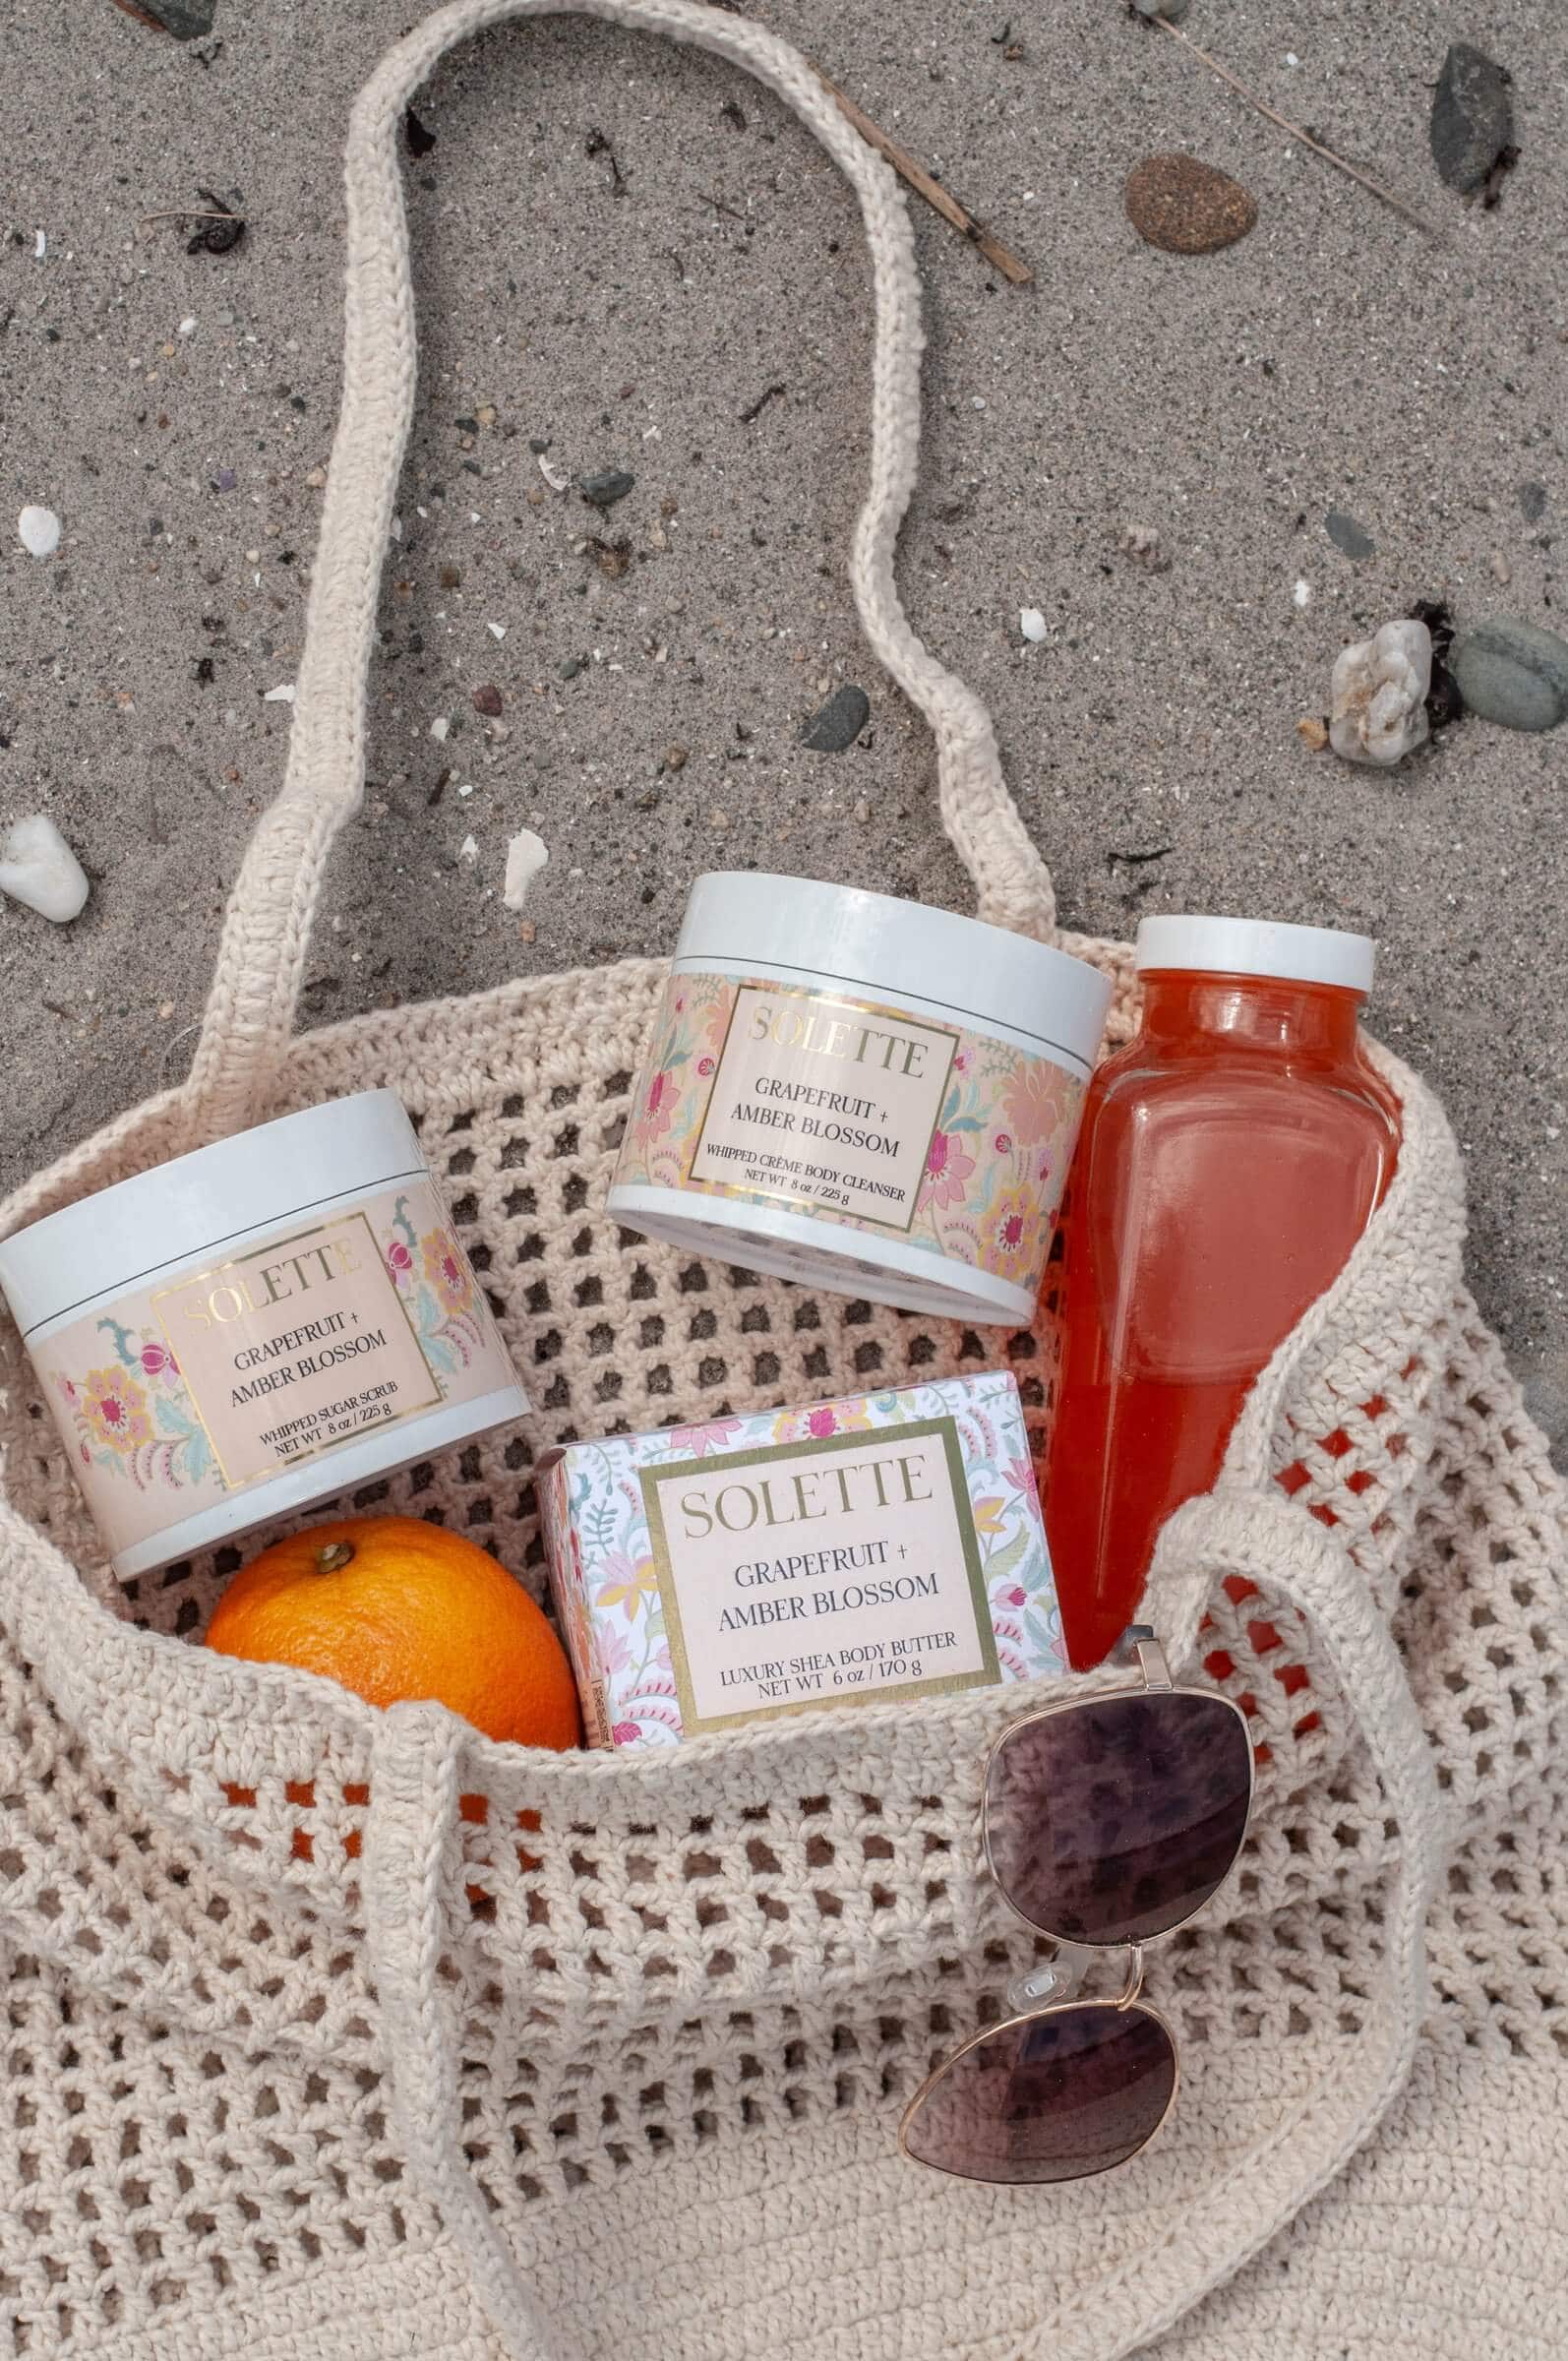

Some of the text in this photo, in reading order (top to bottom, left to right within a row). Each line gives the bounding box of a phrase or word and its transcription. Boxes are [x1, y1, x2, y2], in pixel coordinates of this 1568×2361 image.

[751, 1005, 929, 1079] SOLETTE
[754, 1077, 876, 1120] GRAPEFRUIT
[730, 1103, 900, 1157] AMBER BLOSSOM
[706, 1143, 757, 1164] WHIPPED
[805, 1165, 840, 1183] BODY
[842, 1175, 906, 1202] CLEANSER
[745, 1168, 766, 1183] NET
[768, 1173, 788, 1187] WT
[791, 1180, 798, 1189] 8
[800, 1183, 812, 1193] oz
[820, 1185, 840, 1200] 225
[184, 1238, 362, 1330] SOLETTE
[230, 1329, 387, 1408] AMBER BLOSSOM
[234, 1311, 347, 1370] GRAPEFRUIT
[260, 1380, 398, 1446] WHIPPED SUGAR SCRUB
[274, 1438, 301, 1457] NET
[302, 1428, 324, 1446] WT
[329, 1422, 336, 1433] 8
[338, 1418, 351, 1430] oz
[359, 1406, 381, 1423] 225
[680, 1454, 934, 1541] SOLETTE
[734, 1541, 889, 1589] GRAPEFRUIT
[718, 1572, 939, 1632] AMBER BLOSSOM
[720, 1631, 957, 1687] LUXURY SHEA BODY BUTTER
[757, 1678, 793, 1700] NET
[796, 1673, 822, 1693] WT
[833, 1670, 842, 1684] 6
[846, 1668, 865, 1681] oz
[878, 1660, 908, 1678] 170
